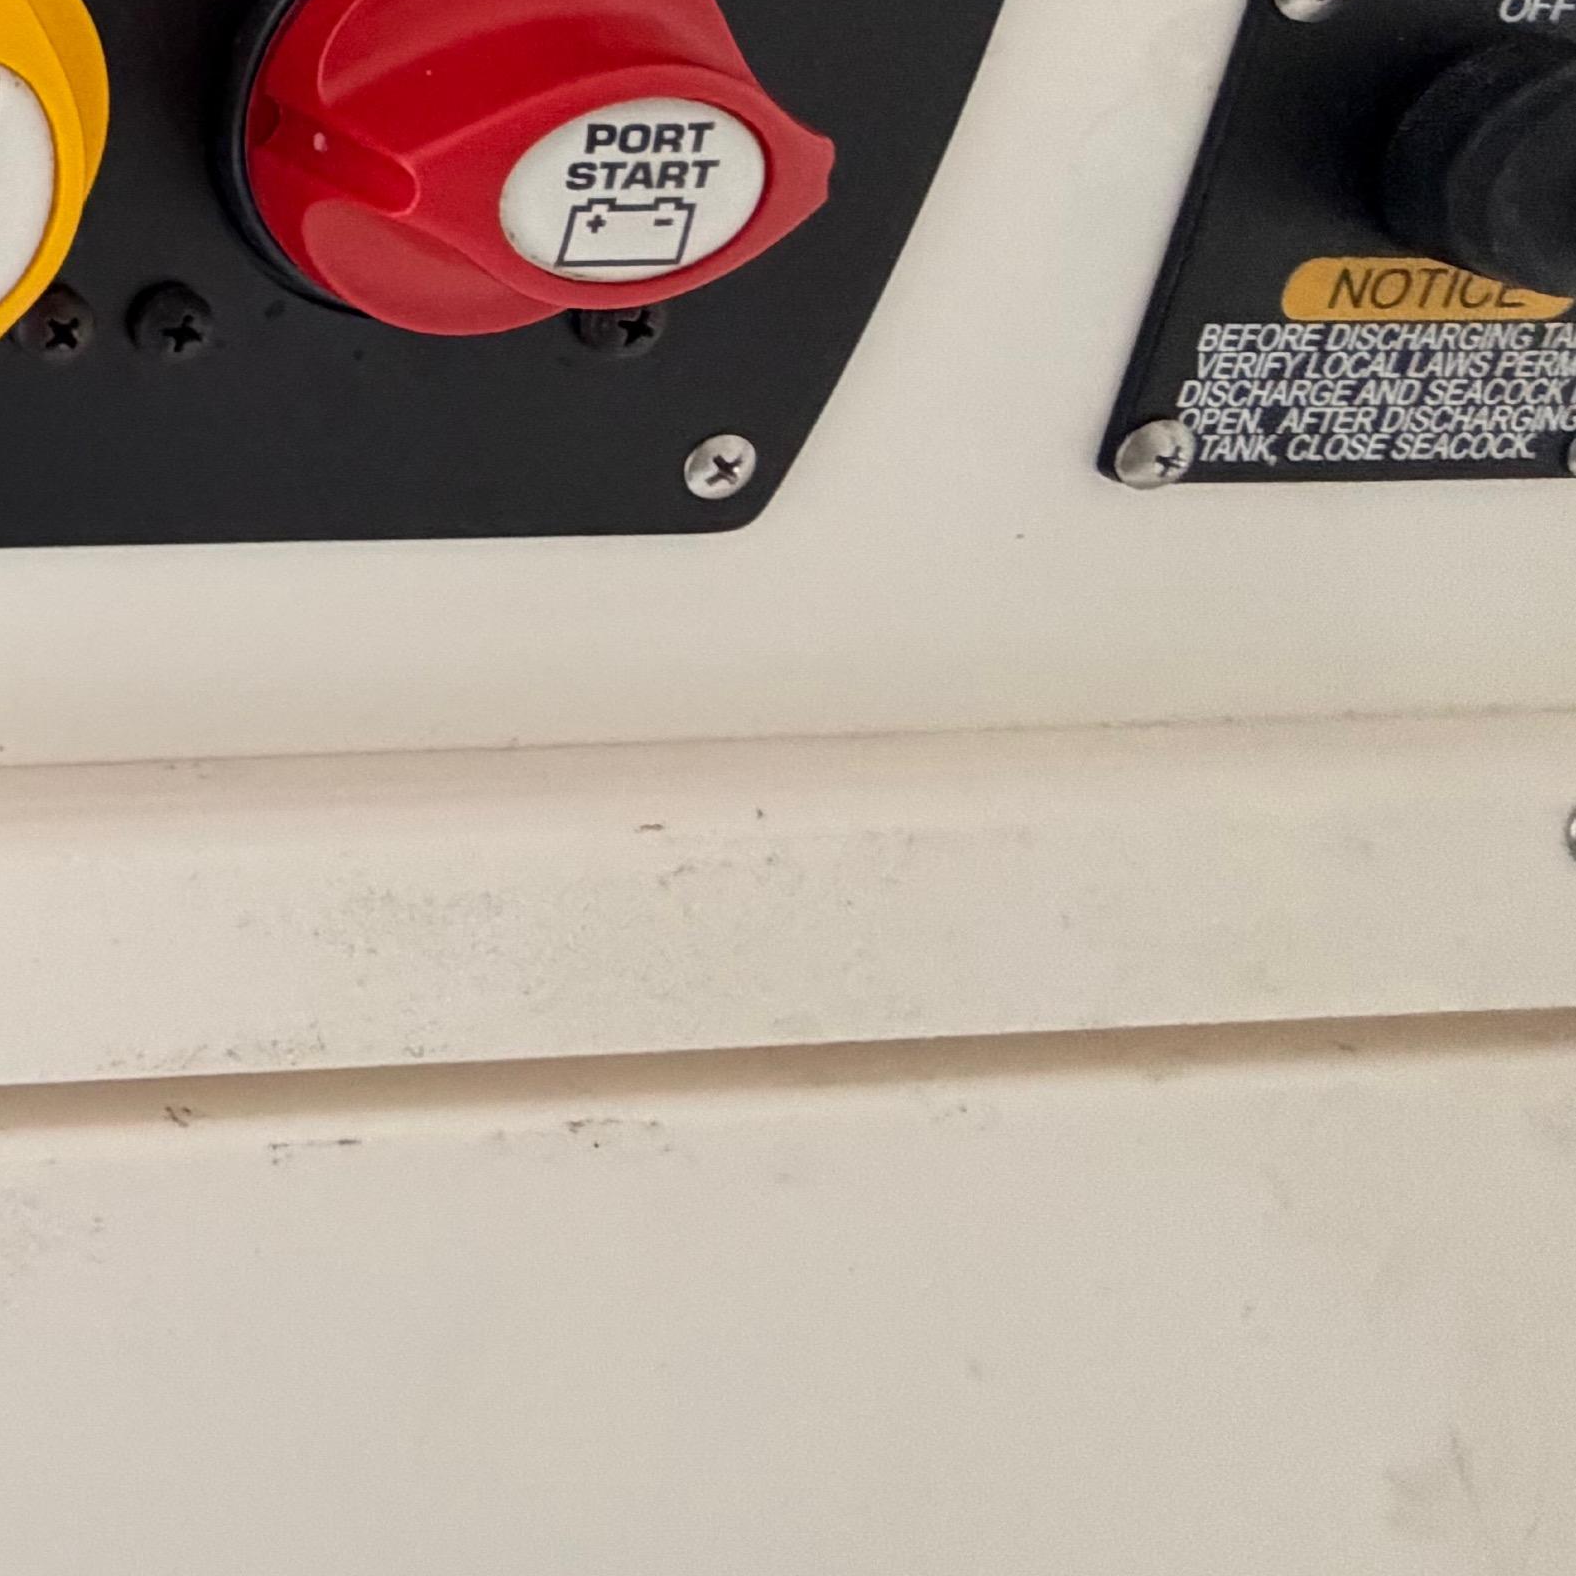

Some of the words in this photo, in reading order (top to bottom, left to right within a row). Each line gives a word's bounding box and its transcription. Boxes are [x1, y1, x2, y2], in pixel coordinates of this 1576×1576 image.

[584, 122, 716, 154] PORT
[565, 159, 720, 191] START
[1197, 323, 1325, 352] BEFORE
[1325, 323, 1535, 352] DISCHARGING
[1197, 352, 1307, 380] VERIFY
[1304, 351, 1403, 379] LOCAL
[1407, 351, 1492, 378] LAWS
[1176, 379, 1356, 408] DISCHARGE
[1354, 379, 1422, 407] AND
[1424, 378, 1571, 405] SEACOCK
[1276, 407, 1375, 433] AFTER
[1380, 405, 1576, 432] DISCHARGING
[1199, 434, 1277, 466] TANK,
[1286, 434, 1388, 462] CLOSE
